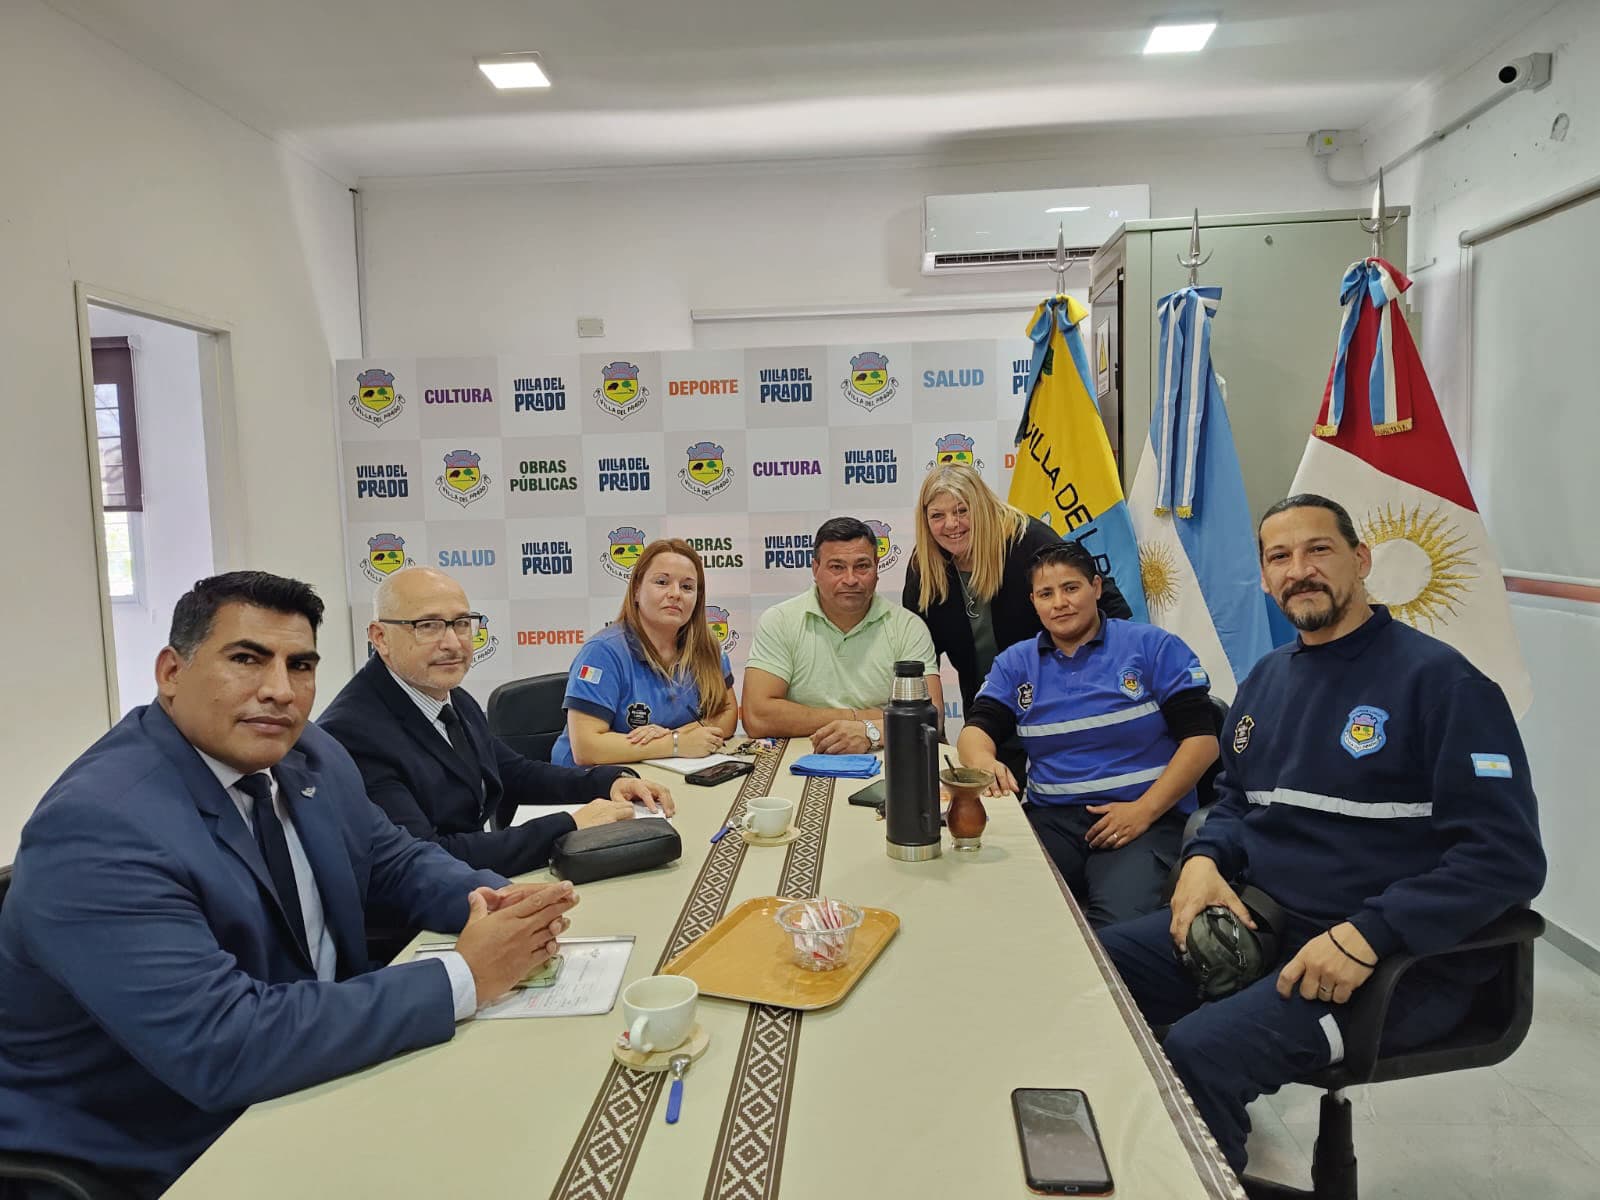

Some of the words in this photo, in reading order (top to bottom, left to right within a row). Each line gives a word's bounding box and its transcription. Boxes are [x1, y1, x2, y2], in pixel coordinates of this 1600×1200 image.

[1013, 360, 1031, 373] VIL
[760, 368, 788, 382] VILLA
[790, 368, 812, 381] DEL
[924, 369, 983, 387] SALUD
[514, 378, 542, 391] VILLA
[543, 377, 564, 390] DEL
[669, 379, 738, 396] DEPORTE
[425, 388, 492, 404] CULTURA
[761, 383, 812, 403] PRADO
[847, 390, 864, 404] VILLA
[515, 392, 565, 412] PRADO
[600, 399, 616, 413] VILLA
[356, 406, 372, 420] VILLA
[845, 450, 873, 464] VILLA
[875, 449, 896, 463] DEL
[356, 465, 384, 478] VILLA
[386, 465, 407, 477] DEL
[520, 460, 566, 474] OBRAS
[599, 458, 627, 471] VILLA
[628, 458, 649, 470] DEL
[753, 461, 821, 476] CULTURA
[845, 464, 897, 484] PRADO
[357, 479, 408, 498] PRADO
[510, 475, 577, 491] PÚBLICAS
[599, 472, 650, 492] PRADO
[685, 479, 700, 493] VILLA
[442, 486, 458, 500] VILLA
[522, 542, 549, 555] VILLA
[551, 542, 571, 554] DEL
[765, 536, 792, 549] VILLA
[794, 535, 813, 548] DEL
[439, 550, 495, 566] SALUD
[522, 556, 572, 575] PRADO
[700, 554, 743, 569] LICAS
[518, 630, 584, 645] DEPORTE
